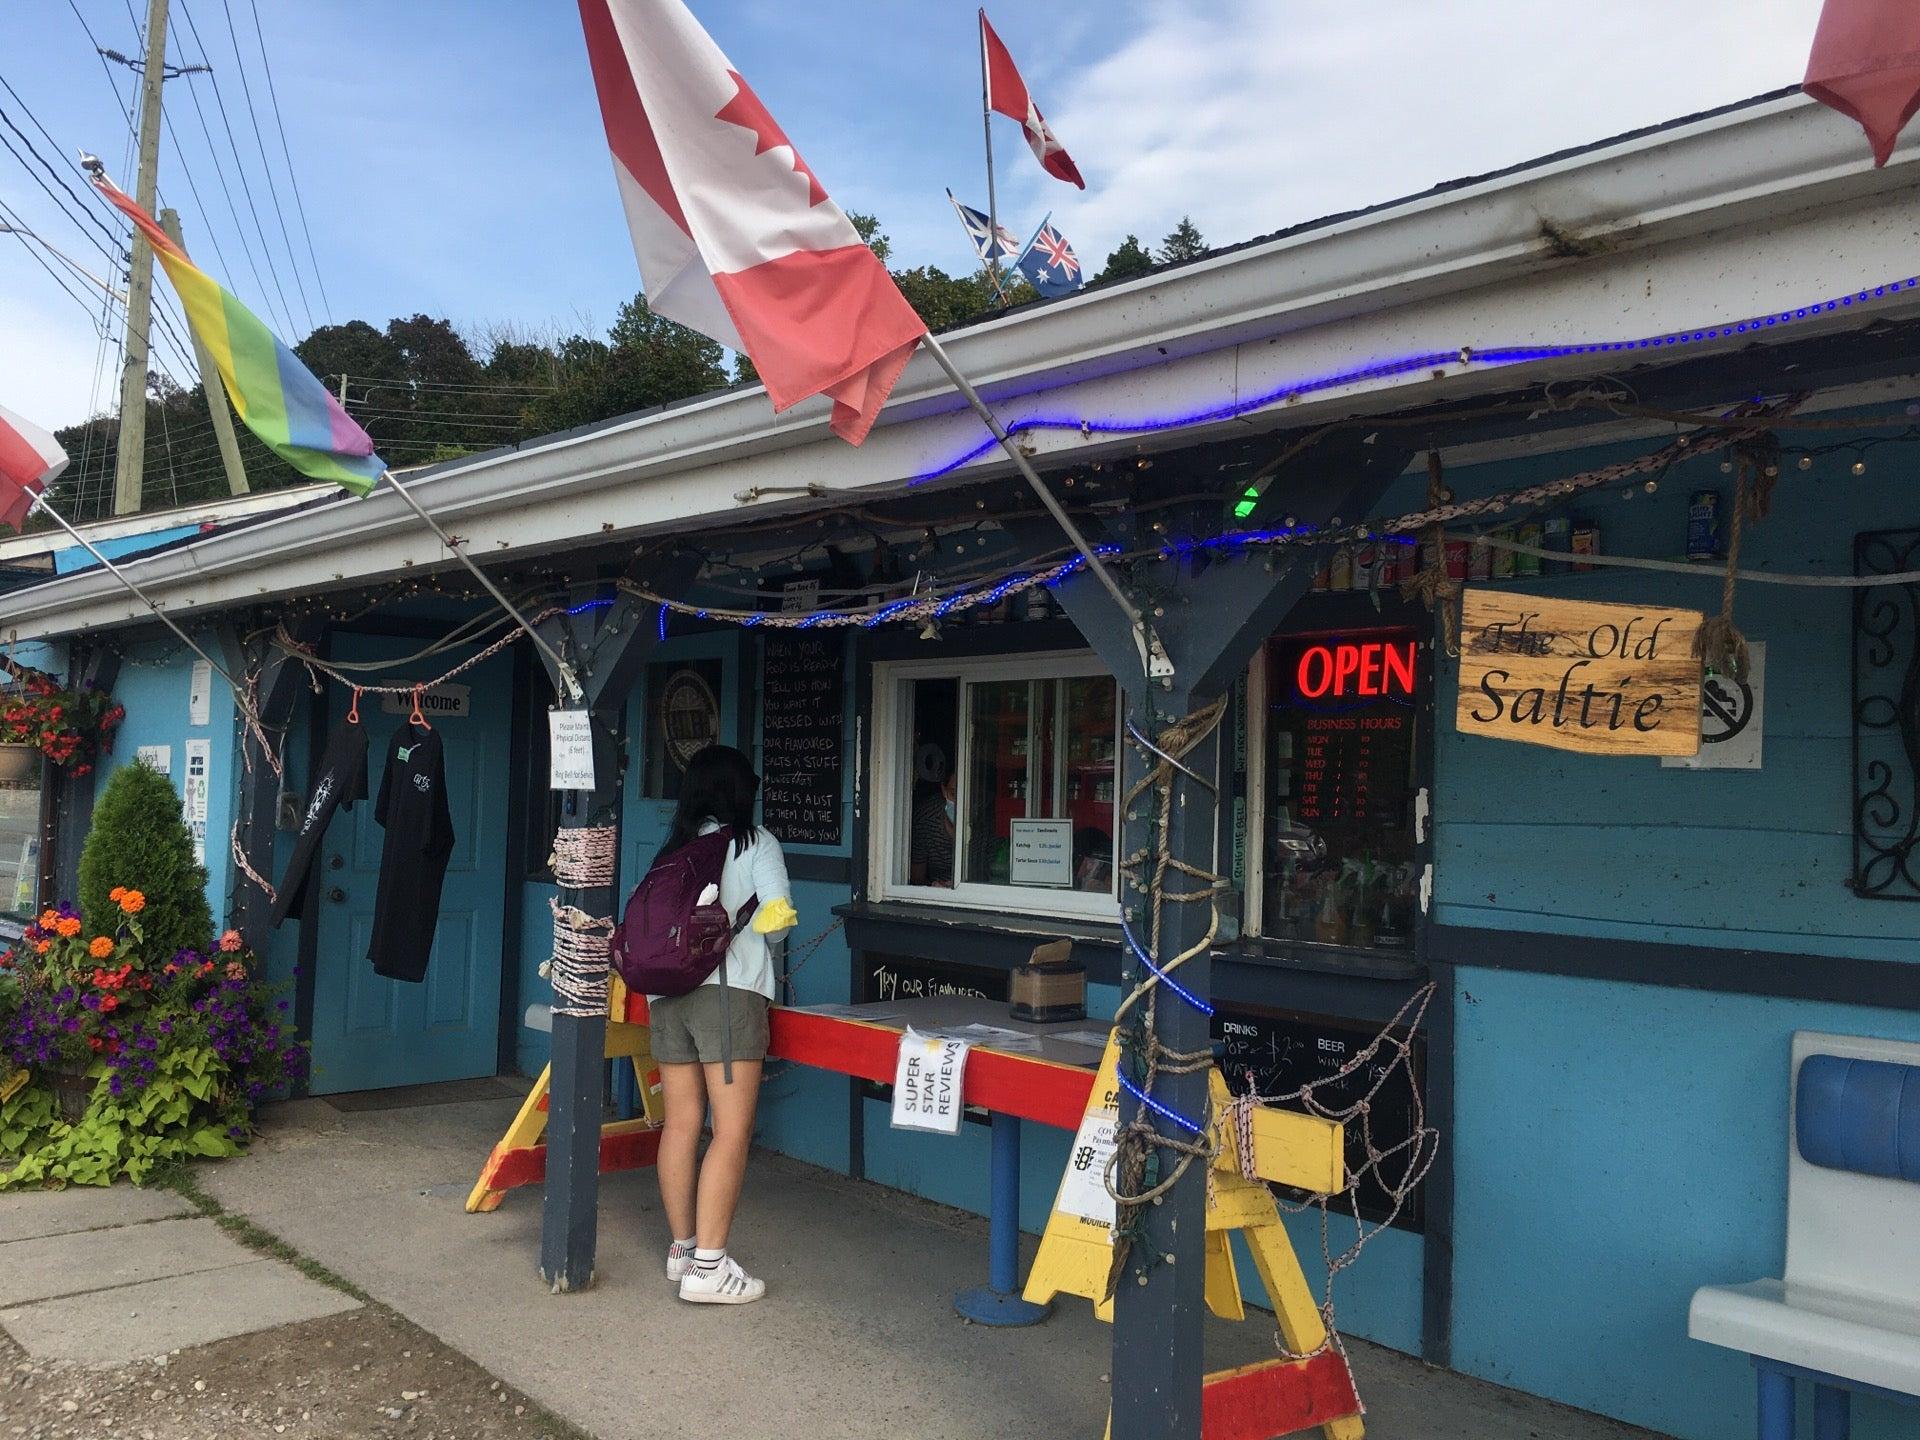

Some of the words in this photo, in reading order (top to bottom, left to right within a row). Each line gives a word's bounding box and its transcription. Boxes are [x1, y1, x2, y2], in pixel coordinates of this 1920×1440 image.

[1480, 611, 1556, 654] The
[1588, 616, 1673, 661] Old
[799, 640, 825, 659] YOUR
[1298, 641, 1416, 698] OPEN
[766, 681, 791, 693] TELL
[794, 680, 807, 693] US
[811, 679, 832, 691] HOW
[811, 696, 822, 709] IT
[1470, 660, 1664, 733] Saltie
[765, 714, 813, 729] DRESSED
[1307, 718, 1356, 730] BUSINESS
[1360, 716, 1402, 729] HOURS
[764, 738, 783, 751] OUR
[784, 736, 834, 751] FLAVOURED
[1306, 735, 1329, 745] MON
[1307, 748, 1324, 756] TUE
[803, 756, 840, 770] STUFF
[1304, 759, 1326, 768] WED
[1304, 771, 1323, 780] THU
[792, 792, 802, 805] IS
[813, 794, 833, 806] LIST
[1302, 796, 1319, 804] SAT
[776, 808, 797, 820] THEM
[803, 810, 815, 823] ON
[818, 810, 832, 823] THE
[1236, 804, 1245, 829] BELL
[1301, 809, 1320, 817] SUN
[788, 824, 816, 839] BEHIND
[1235, 832, 1244, 849] THE
[1234, 851, 1243, 879] RING
[873, 965, 897, 1001] TRY
[902, 979, 924, 999] OUR
[1223, 1022, 1258, 1037] DRINKS
[1317, 1038, 1345, 1053] BEER
[905, 1057, 921, 1112] SUPER
[938, 1041, 961, 1115] REVIEWS
[922, 1072, 936, 1114] STAR
